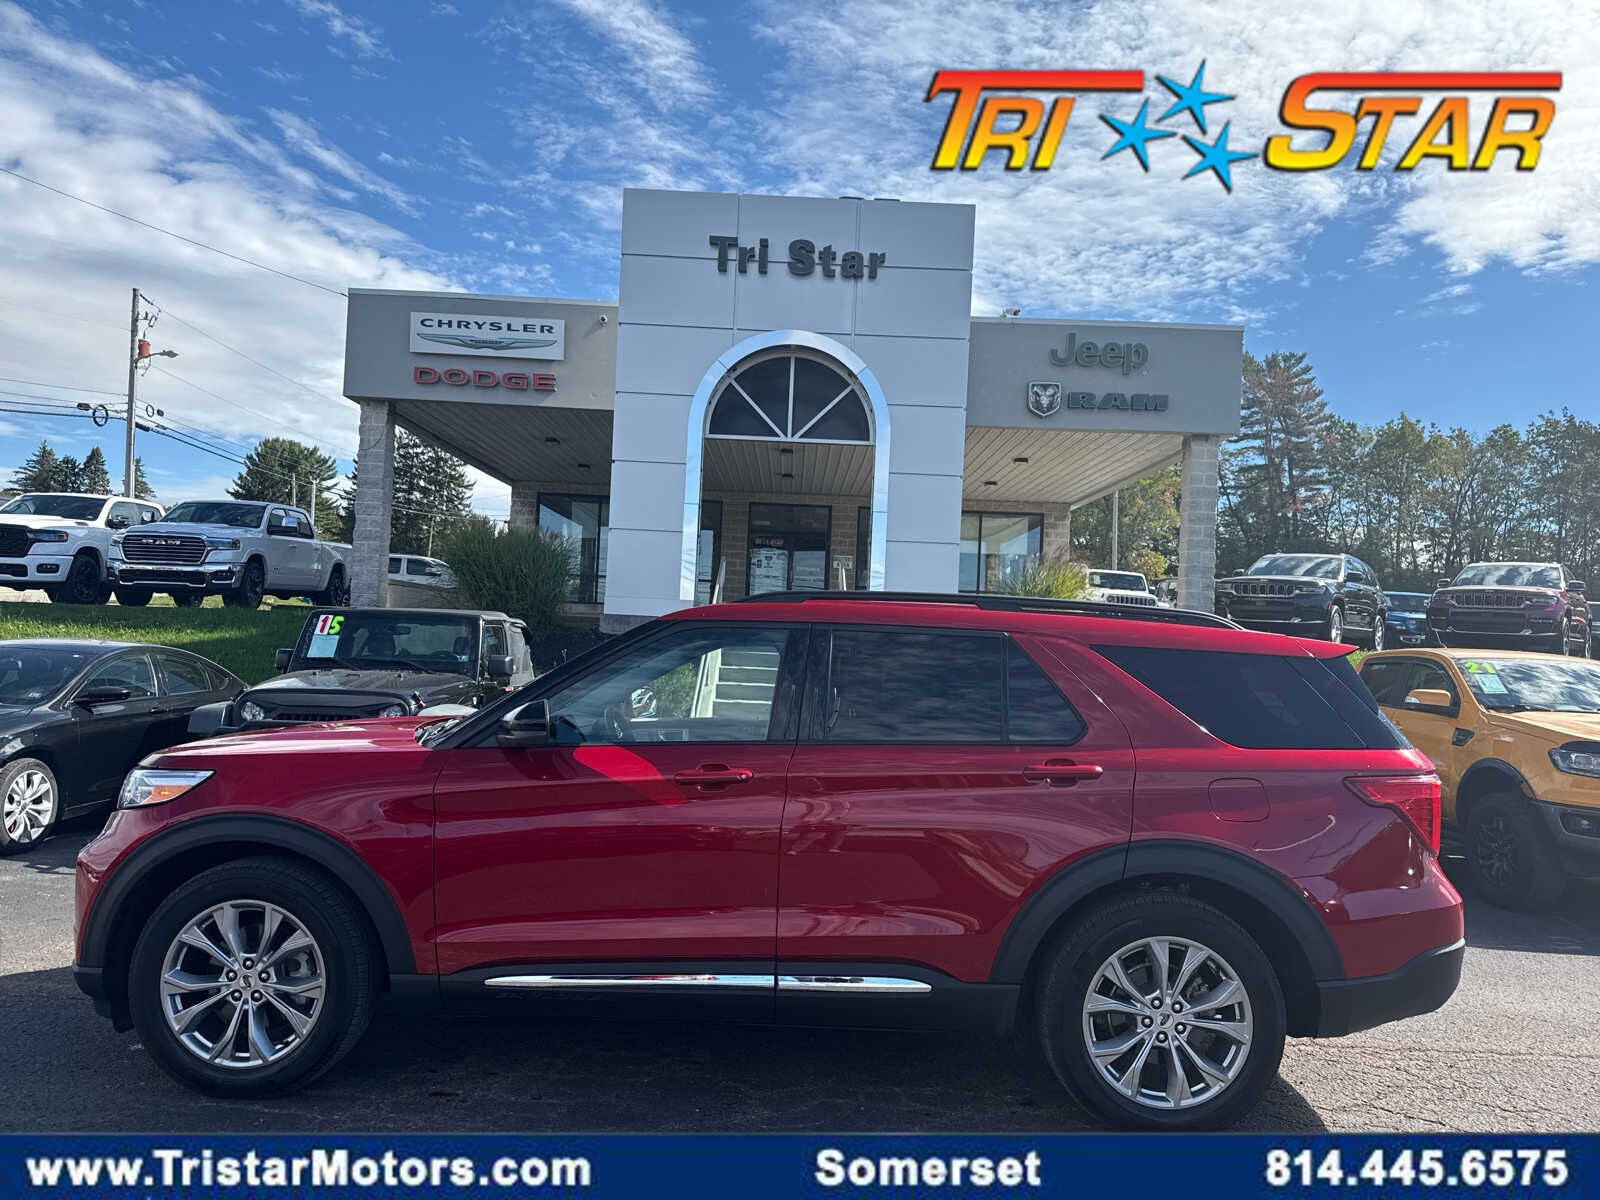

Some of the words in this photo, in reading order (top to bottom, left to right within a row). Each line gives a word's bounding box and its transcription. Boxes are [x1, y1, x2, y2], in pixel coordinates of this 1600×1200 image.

[709, 235, 769, 275] Tri
[787, 239, 886, 280] Star
[420, 317, 555, 334] CHRYSLER
[1050, 332, 1149, 376] Jeep
[413, 366, 557, 392] DODGE
[1067, 391, 1169, 412] RAM
[319, 614, 345, 635] 15
[1464, 661, 1497, 674] 21
